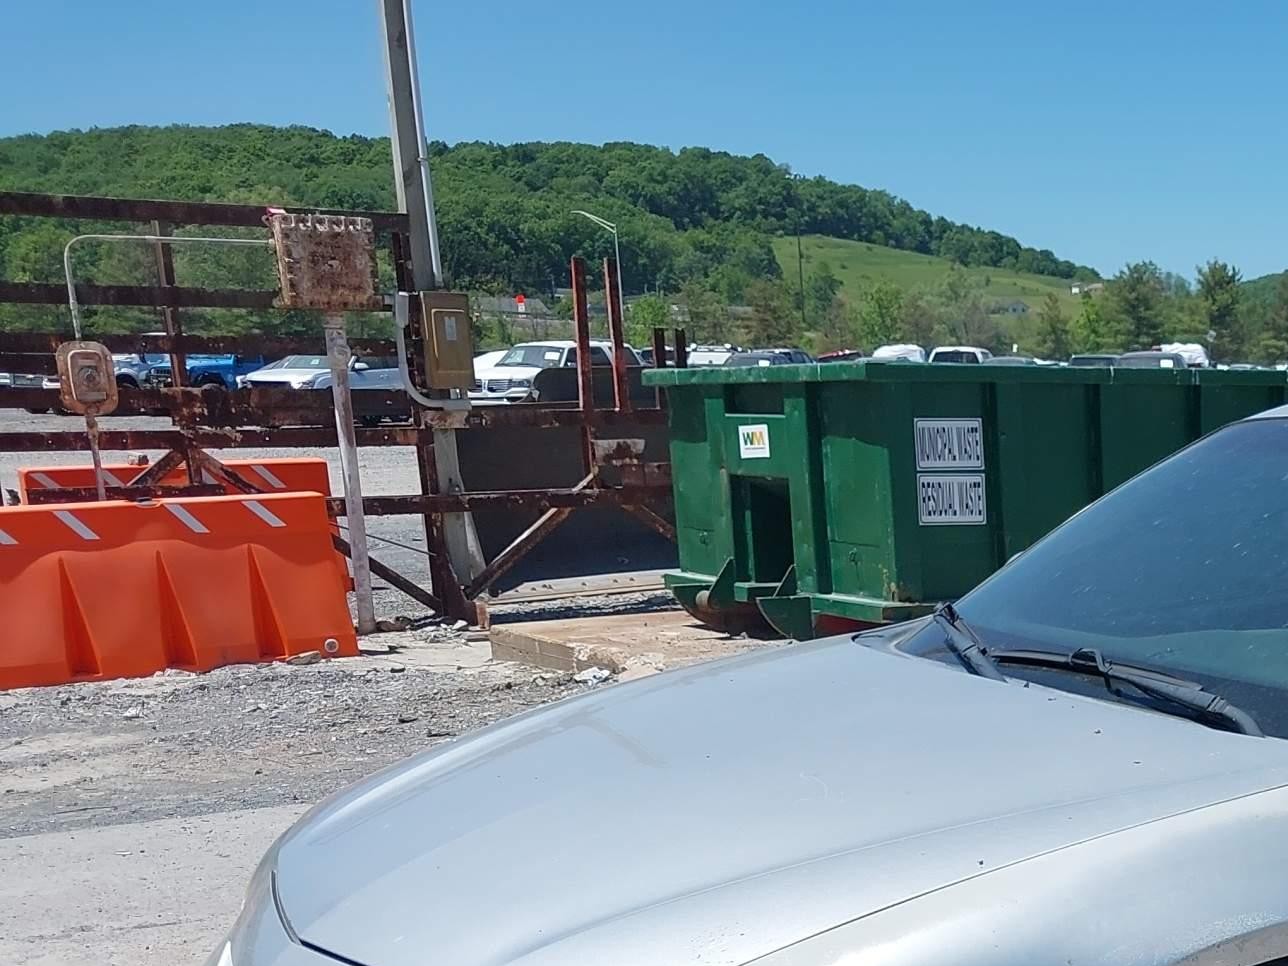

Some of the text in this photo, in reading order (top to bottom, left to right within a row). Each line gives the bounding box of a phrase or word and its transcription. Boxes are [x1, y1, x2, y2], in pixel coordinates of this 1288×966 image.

[742, 431, 766, 446] WM
[957, 426, 980, 461] WASTE
[921, 482, 982, 516] RESIDUAL WASTE
